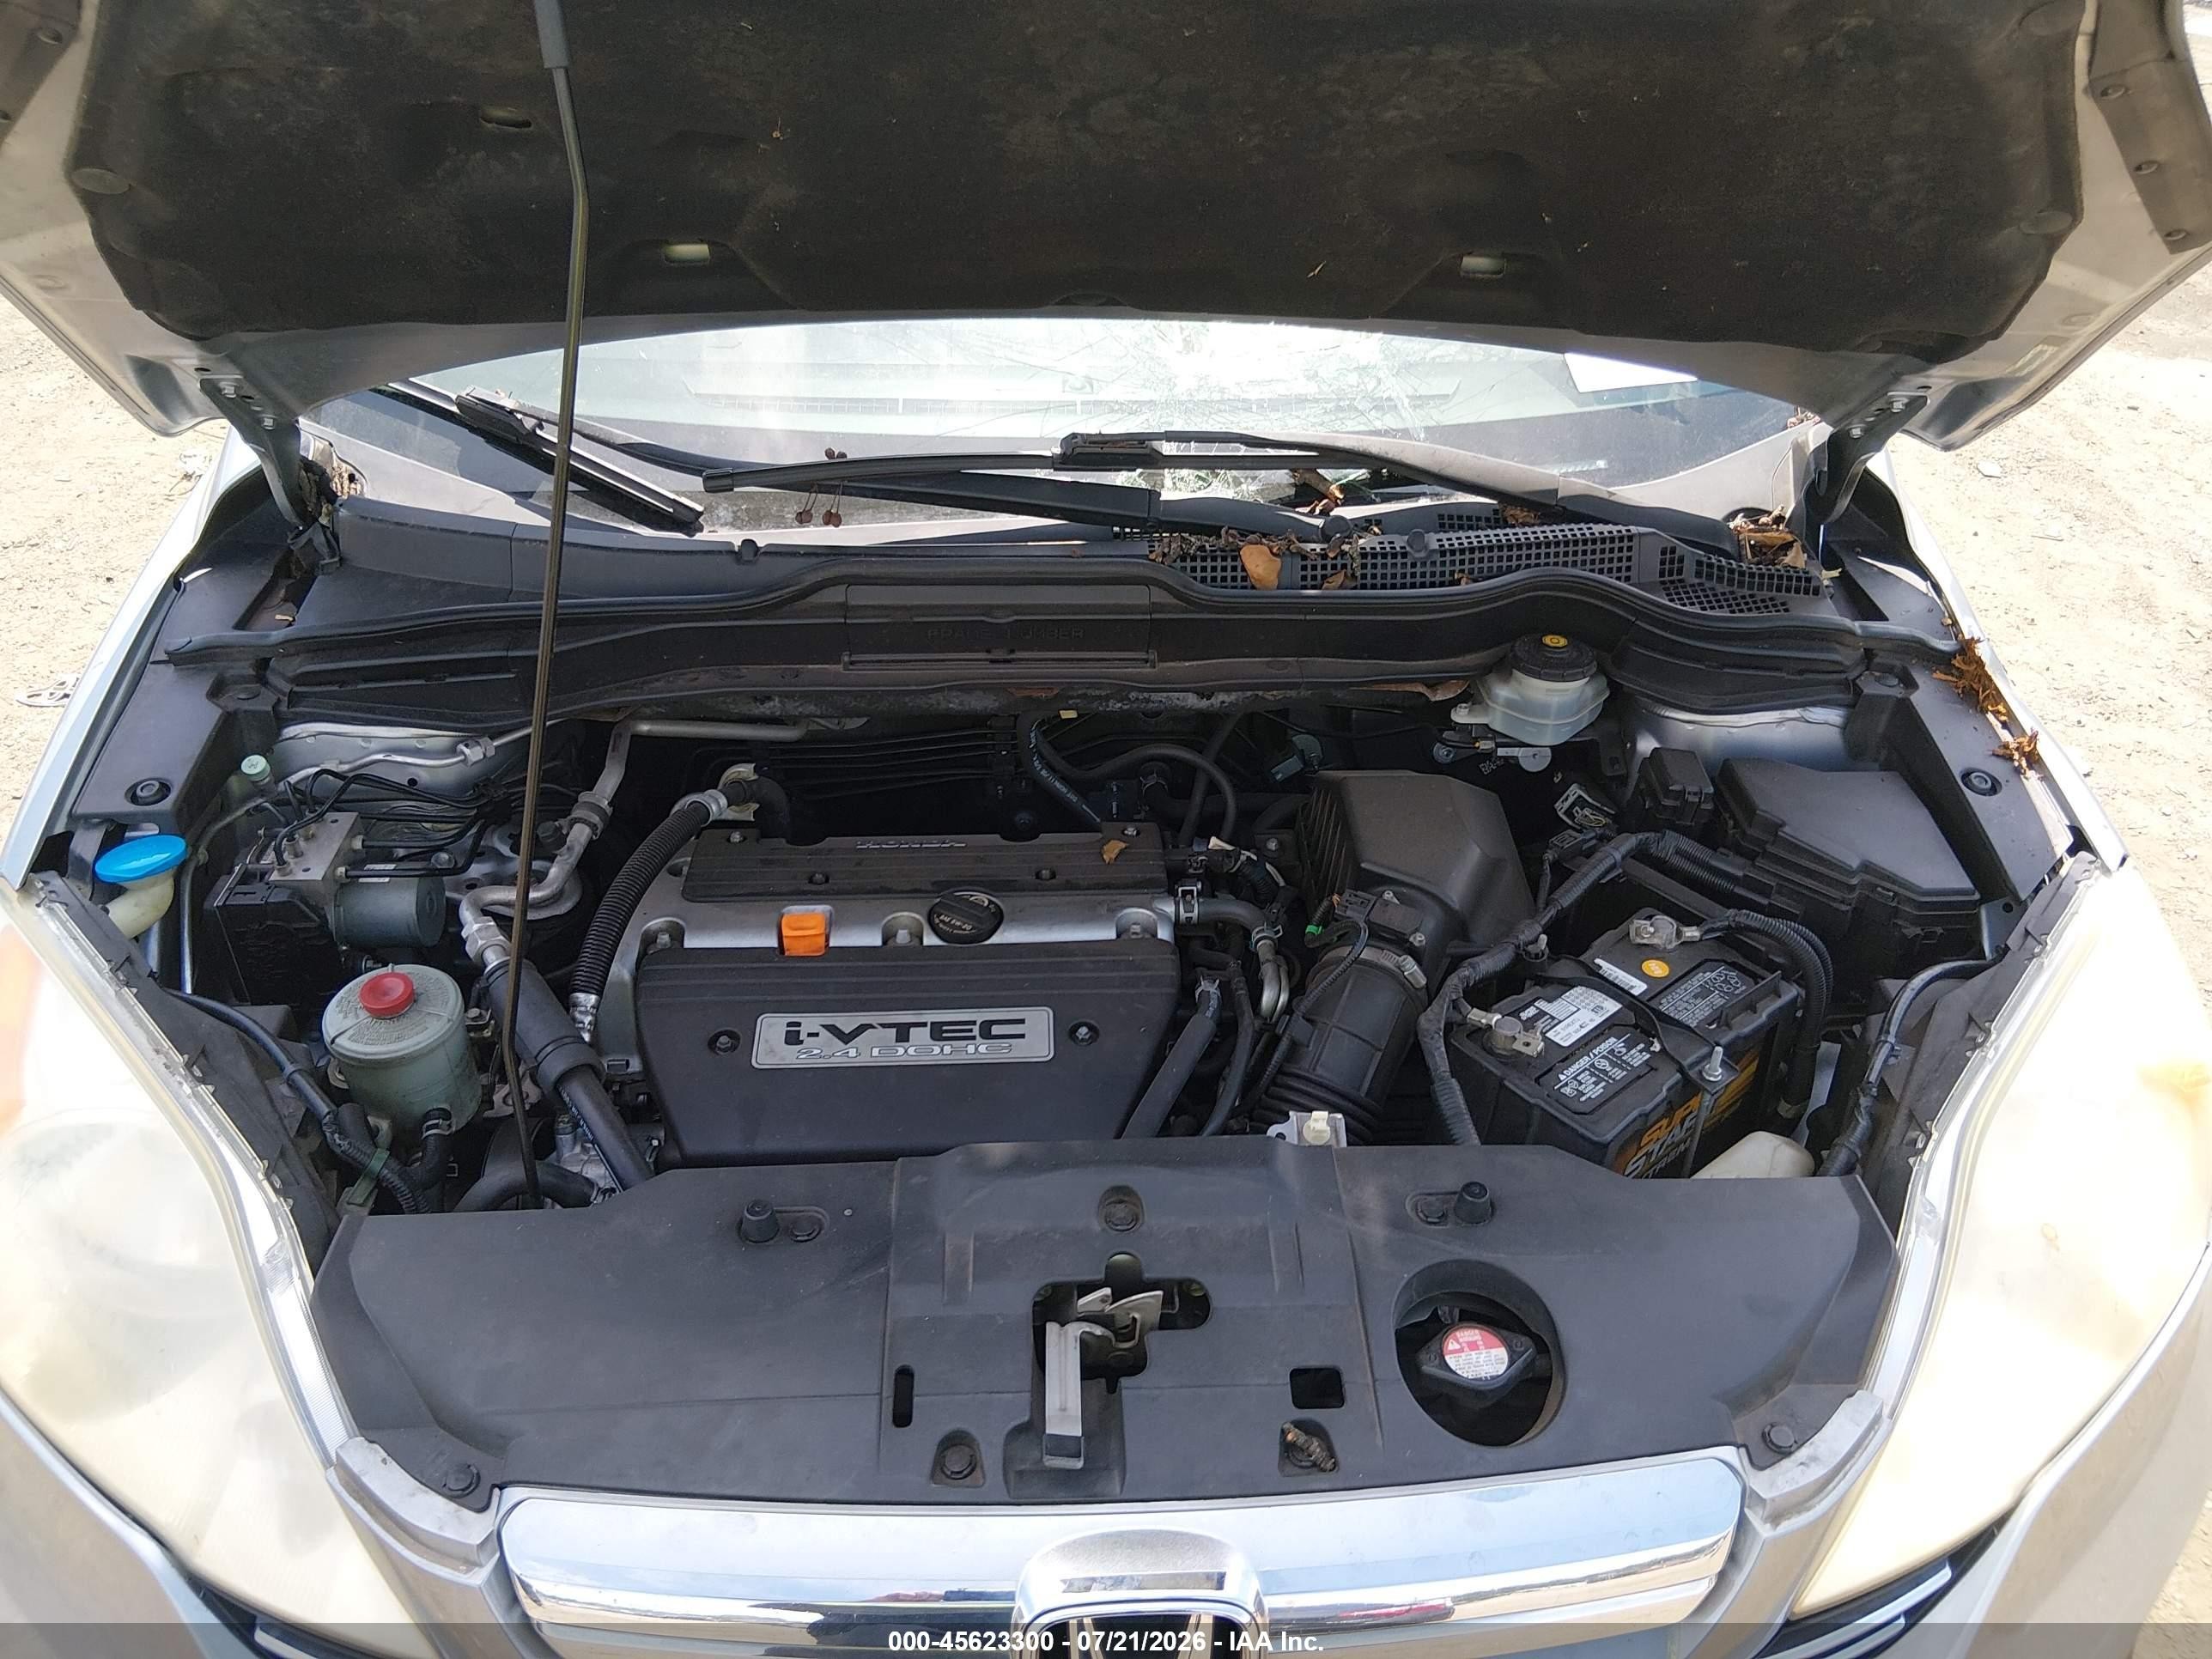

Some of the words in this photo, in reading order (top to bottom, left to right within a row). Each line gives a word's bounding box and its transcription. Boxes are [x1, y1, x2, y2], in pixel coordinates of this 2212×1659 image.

[783, 1018, 1027, 1047] i-VTEC
[795, 1046, 862, 1060] 2.4
[870, 1042, 1013, 1059] DOHC
[1563, 1055, 1592, 1076] DANGER
[1592, 1036, 1619, 1055] POISON
